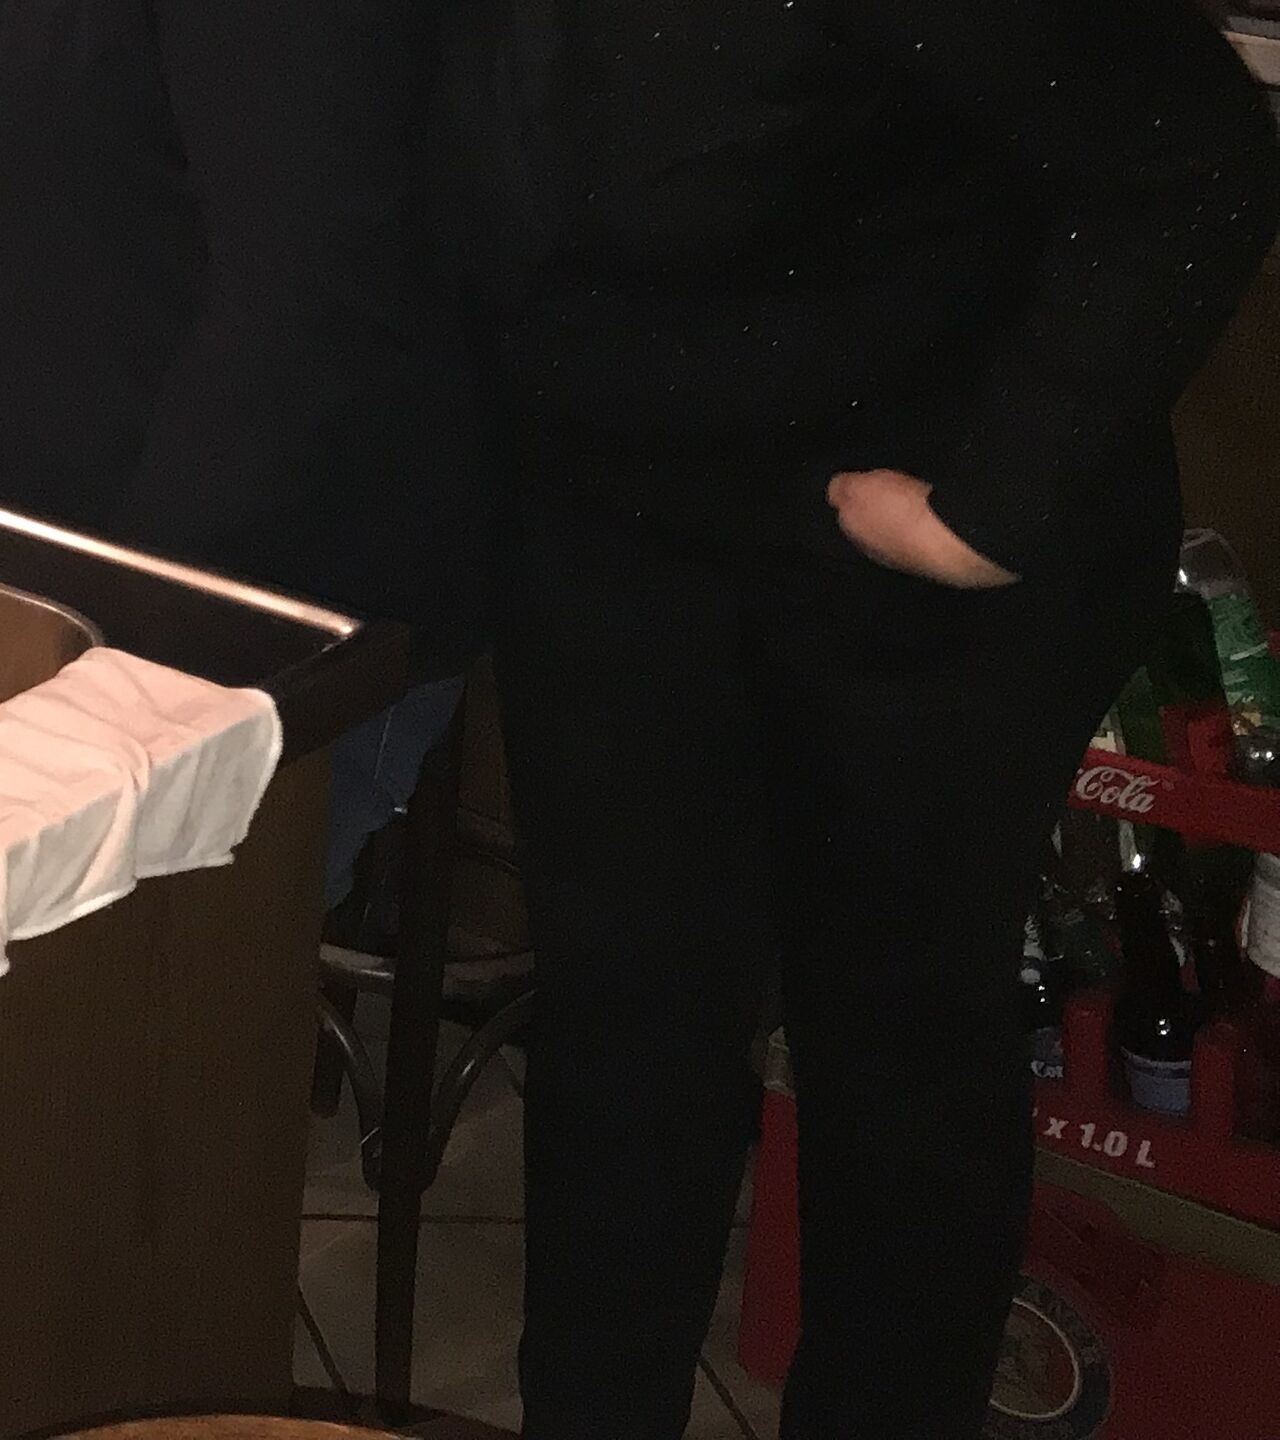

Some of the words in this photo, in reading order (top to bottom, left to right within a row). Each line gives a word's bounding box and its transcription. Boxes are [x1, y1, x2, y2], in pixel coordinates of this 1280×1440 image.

[1044, 1117, 1069, 1139] x
[1080, 1122, 1129, 1157] 1.0
[1137, 1140, 1157, 1168] L
